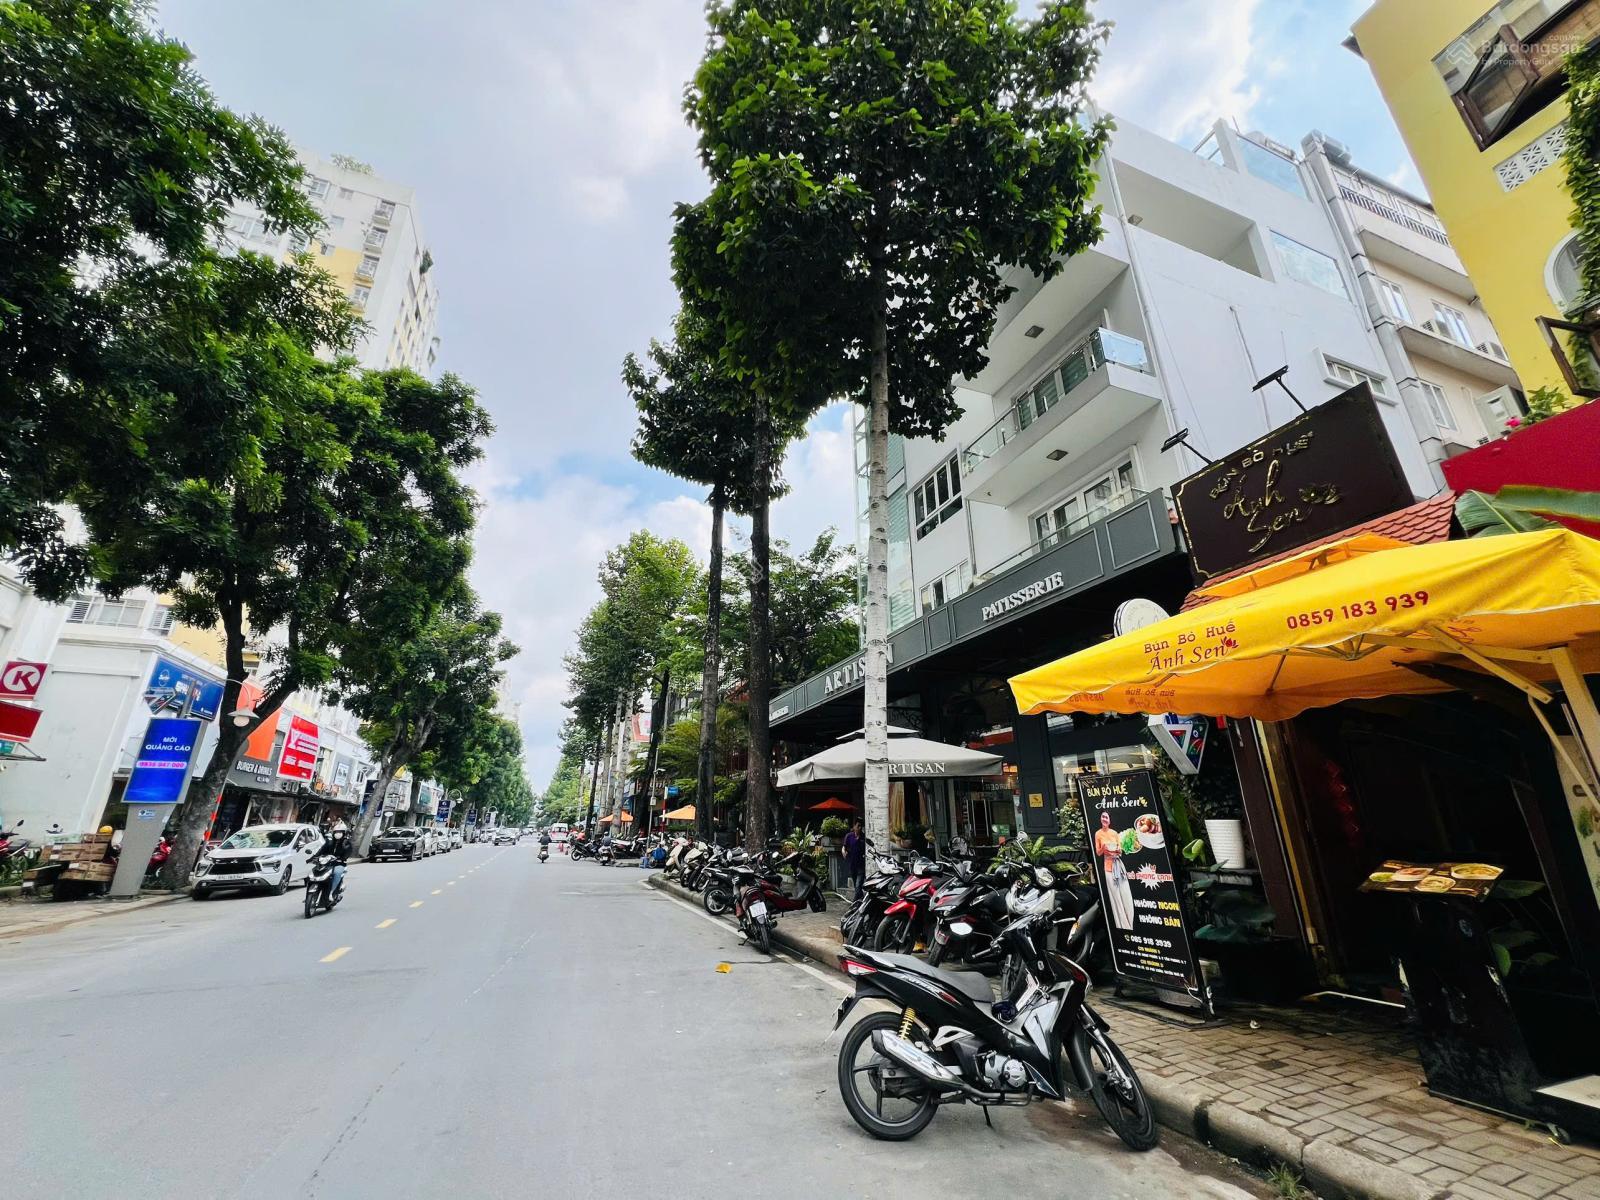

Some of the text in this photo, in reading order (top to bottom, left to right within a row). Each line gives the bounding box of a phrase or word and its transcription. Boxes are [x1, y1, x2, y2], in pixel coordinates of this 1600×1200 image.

[982, 571, 1064, 621] PATISSERIE
[1286, 590, 1429, 629] 0859 183 939
[1144, 620, 1236, 654] Bún Bò Huế
[824, 643, 894, 694] ARTISN
[1146, 644, 1228, 675] Ánh Sen
[12, 671, 36, 691] K
[888, 762, 945, 775] RTISAN
[1086, 780, 1128, 797] BÚN BÒ HUẾ
[1121, 796, 1140, 808] Sen
